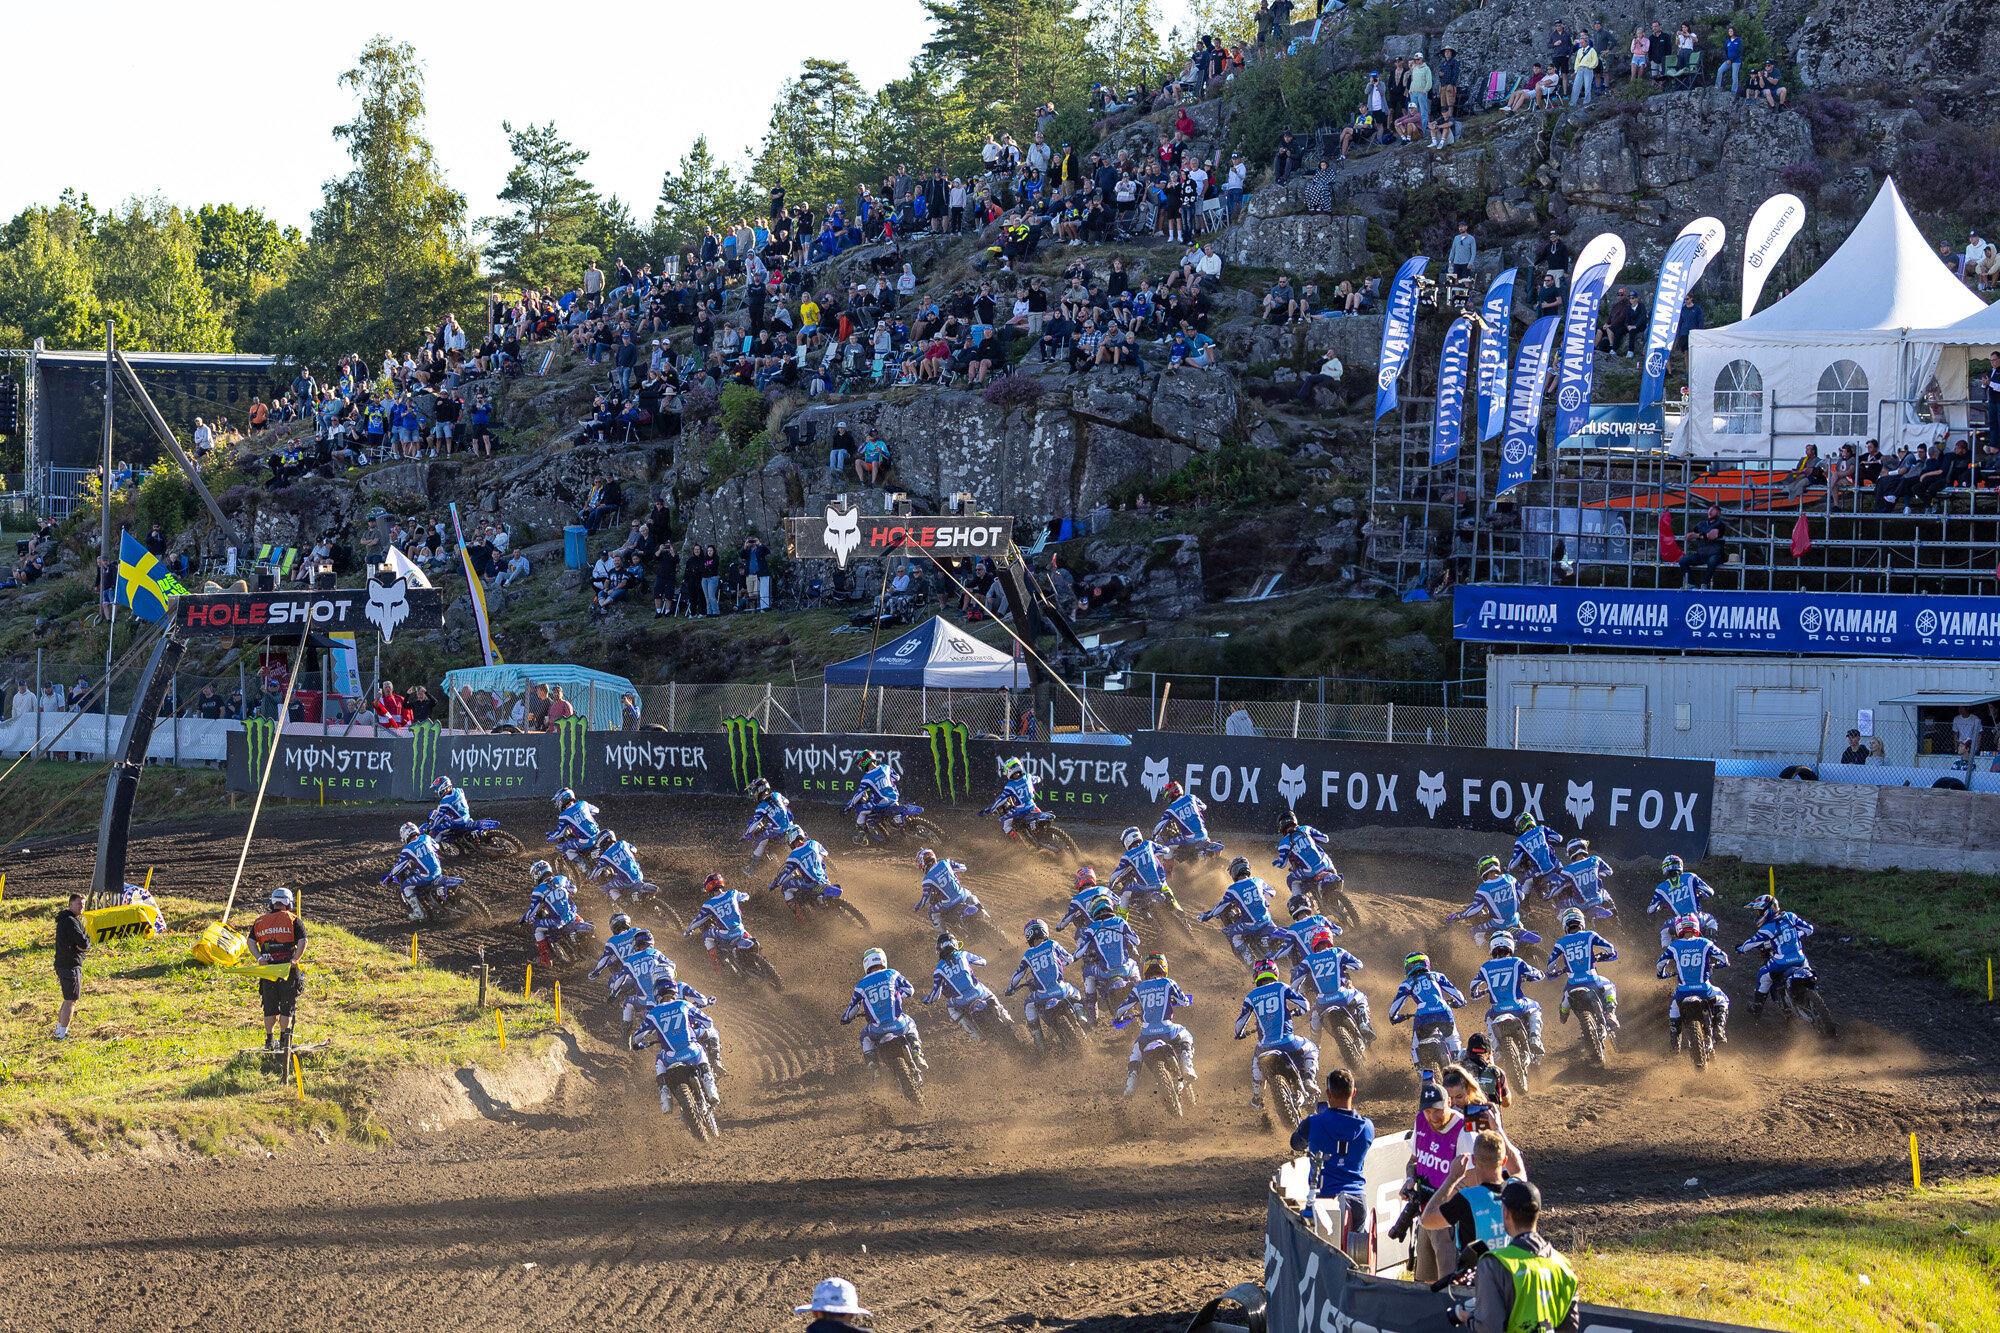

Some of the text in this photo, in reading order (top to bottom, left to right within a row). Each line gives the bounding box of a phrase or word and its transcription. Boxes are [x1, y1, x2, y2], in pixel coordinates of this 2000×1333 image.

[1757, 205, 1796, 257] Husqvarna
[1692, 228, 1718, 261] qvarna
[1650, 261, 1684, 350] YAMAHA
[1383, 279, 1414, 364] YAMAHA
[1562, 291, 1593, 383] YAMAHA
[1582, 298, 1599, 403] RACING
[1508, 343, 1542, 436] YAMAHA
[1527, 351, 1548, 456] RACING
[1581, 416, 1654, 437] Husqvarna
[871, 527, 1002, 547] HOLESHOT
[187, 600, 352, 626] HOLESHOT
[1599, 603, 1668, 628] YAMAHA
[1709, 606, 1780, 631] YAMAHA
[1824, 608, 1898, 634] YAMAHA
[1584, 628, 1663, 636] RACING
[1692, 631, 1776, 639] RACING
[1808, 633, 1891, 643] RACING
[1923, 637, 2000, 646] RACIN
[285, 745, 393, 774] MONSTER
[450, 745, 538, 771] MONSTER
[605, 740, 708, 772] MONSTER
[784, 744, 904, 775] MONSER
[300, 776, 378, 788] ENERGY
[462, 776, 524, 787] ENERGY
[621, 775, 694, 787] ENERGY
[803, 780, 864, 791] ENER
[1184, 764, 1261, 804] FOX
[1322, 771, 1399, 811] FOX
[1034, 791, 1109, 804] NERGY
[1463, 778, 1546, 821] FOX
[1609, 787, 1698, 832] FOX
[1494, 886, 1514, 904] 422
[1668, 885, 1690, 905] 722
[717, 902, 733, 919] 53
[1031, 952, 1054, 972] 581
[1566, 944, 1589, 962] 551
[1680, 953, 1702, 967] 66
[633, 959, 655, 978] 502
[1315, 961, 1336, 979] 22
[1490, 971, 1513, 988] 17
[868, 985, 890, 1005] 56
[1140, 992, 1165, 1009] 785
[1255, 997, 1280, 1016] 19
[660, 1012, 682, 1033] 77
[1429, 1141, 1440, 1153] 52
